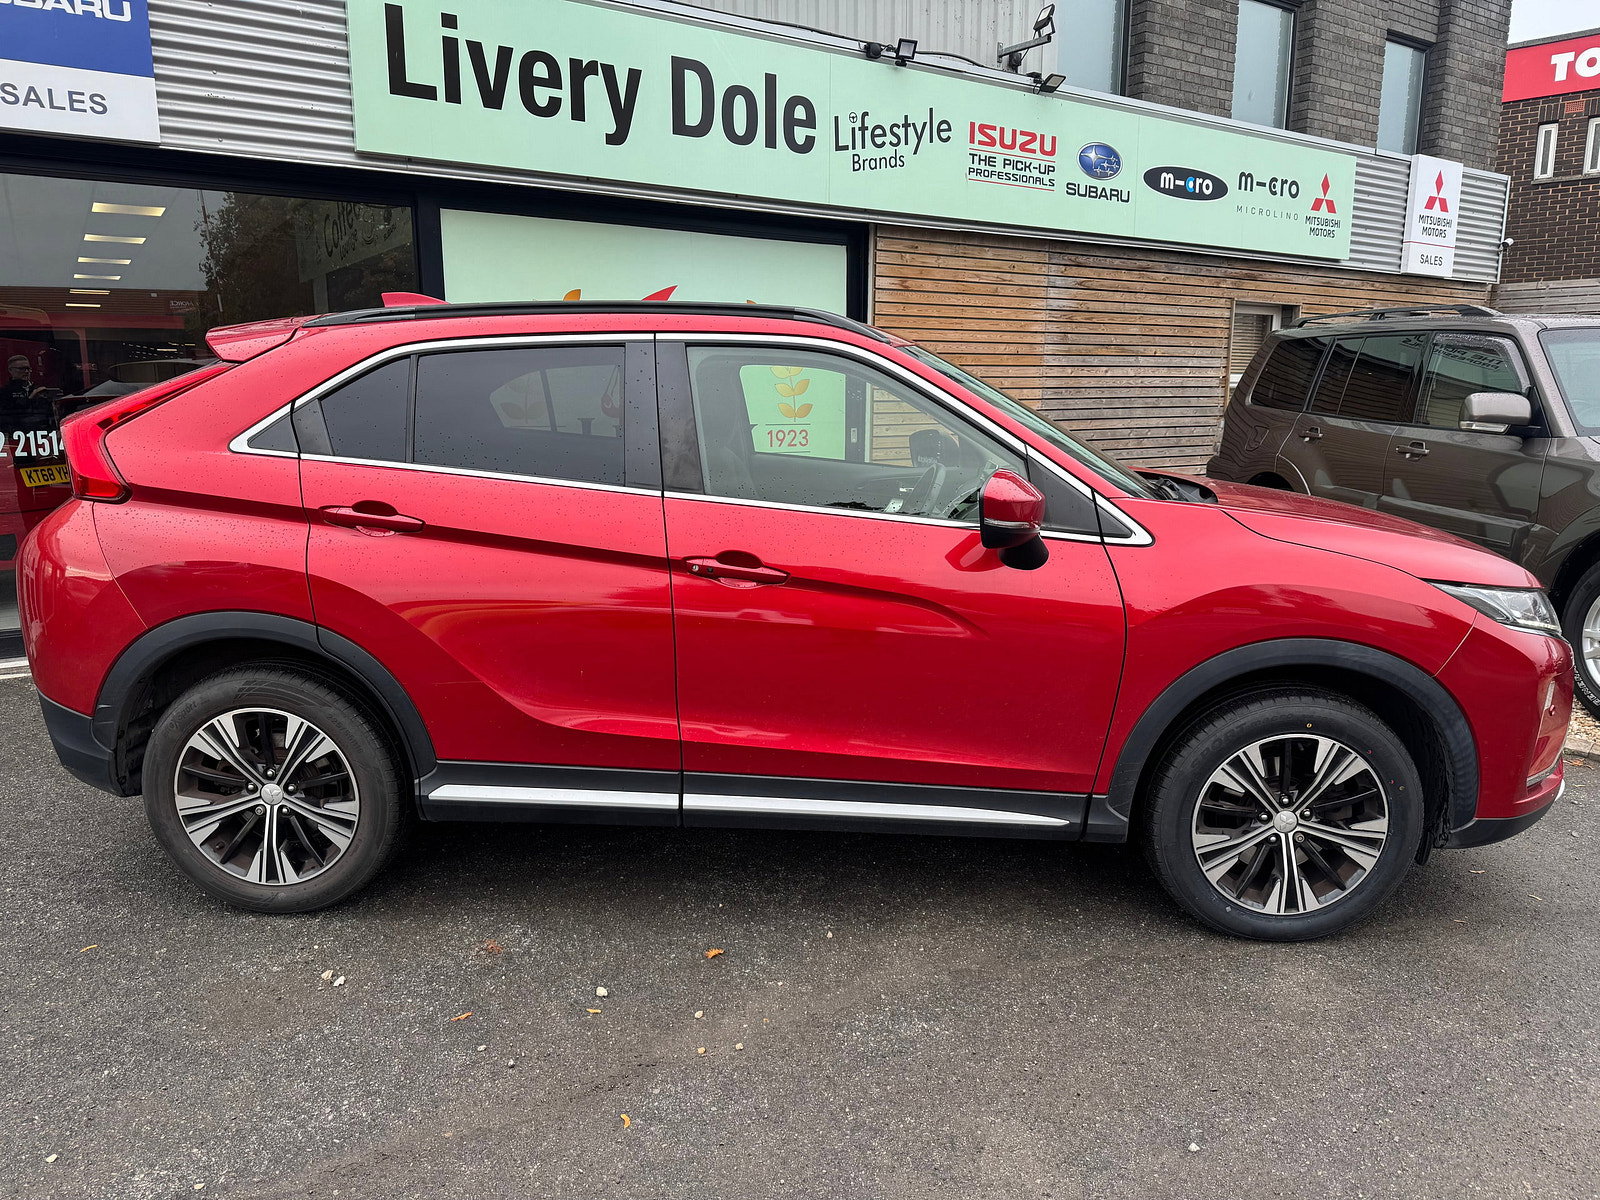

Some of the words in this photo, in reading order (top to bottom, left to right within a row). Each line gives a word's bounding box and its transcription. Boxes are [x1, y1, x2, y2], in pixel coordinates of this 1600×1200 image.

[384, 2, 642, 146] Livery
[670, 55, 817, 154] Dole
[0, 82, 108, 115] SALES
[834, 107, 953, 156] Lifestyle
[968, 121, 1057, 157] ISUZU
[852, 148, 905, 172] Brands
[968, 153, 997, 168] THE
[1003, 158, 1056, 175] PICK-UP
[968, 167, 1055, 187] PROFESSIONALS
[1065, 181, 1131, 204] SUBARU
[1236, 204, 1300, 222] MICROLINO
[1305, 214, 1341, 229] MITSUBISHI
[1418, 213, 1453, 228] MITSUBISHI
[1309, 226, 1336, 239] MOTORS
[1421, 225, 1447, 239] MOTORS
[1419, 253, 1444, 267] SALES
[766, 429, 810, 449] 1923
[25, 467, 56, 484] KT68
